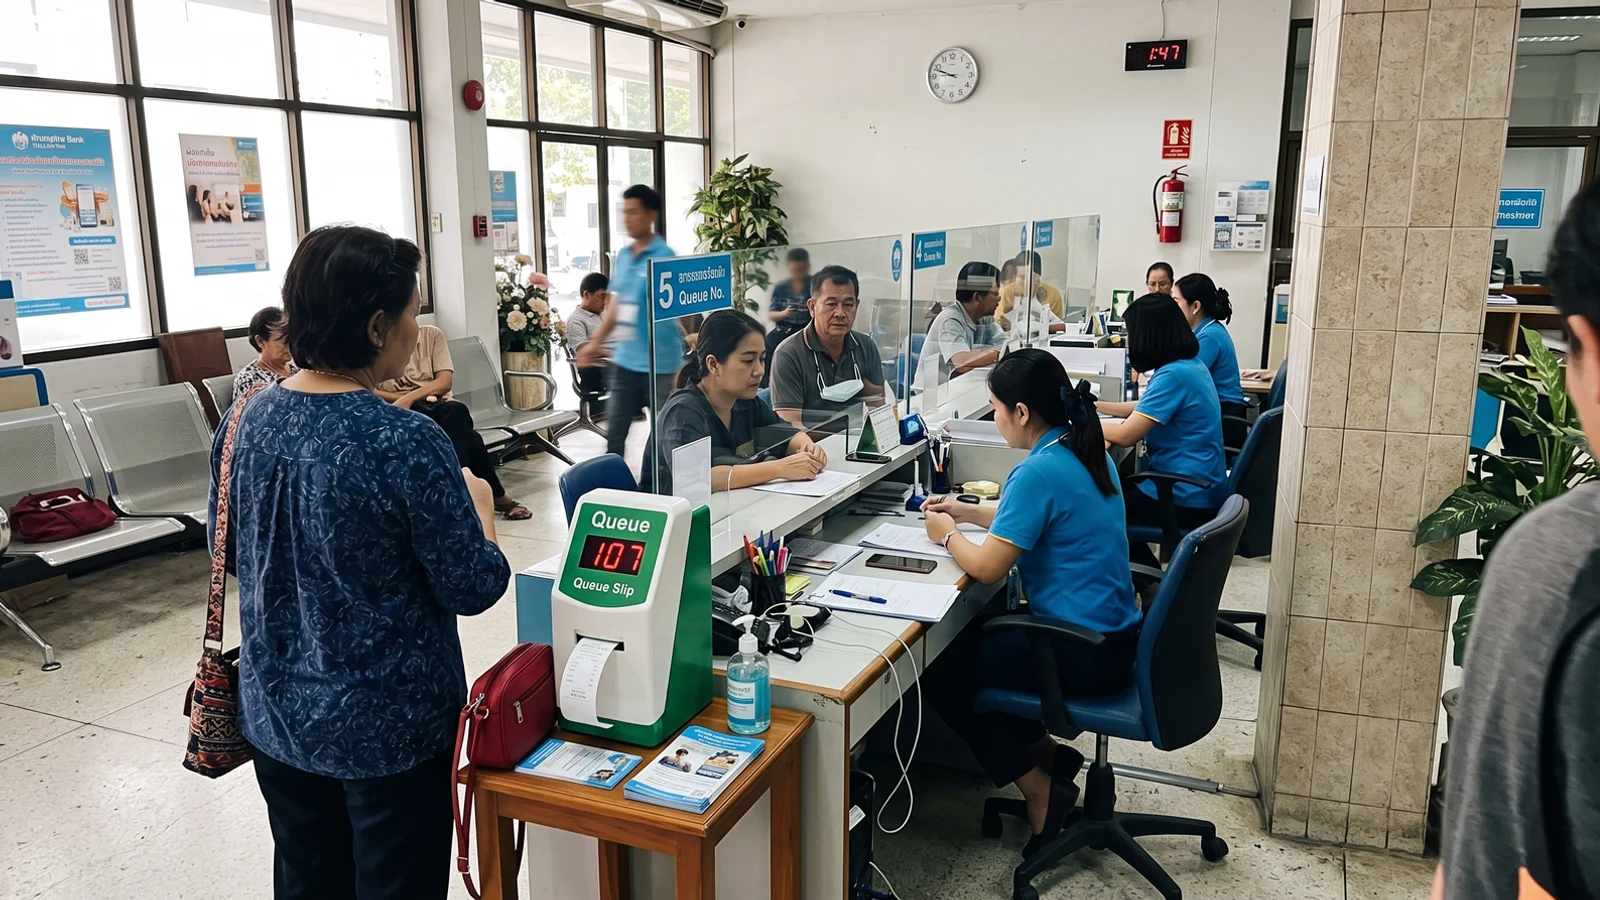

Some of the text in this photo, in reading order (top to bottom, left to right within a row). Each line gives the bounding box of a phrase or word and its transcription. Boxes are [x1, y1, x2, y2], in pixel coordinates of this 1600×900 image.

[1149, 44, 1180, 61] 1:47
[916, 240, 922, 263] 4
[659, 271, 674, 309] 5
[679, 286, 725, 306] Queue No.
[591, 510, 651, 533] Queue
[594, 542, 644, 572] 107
[573, 577, 635, 598] Queue Slip
